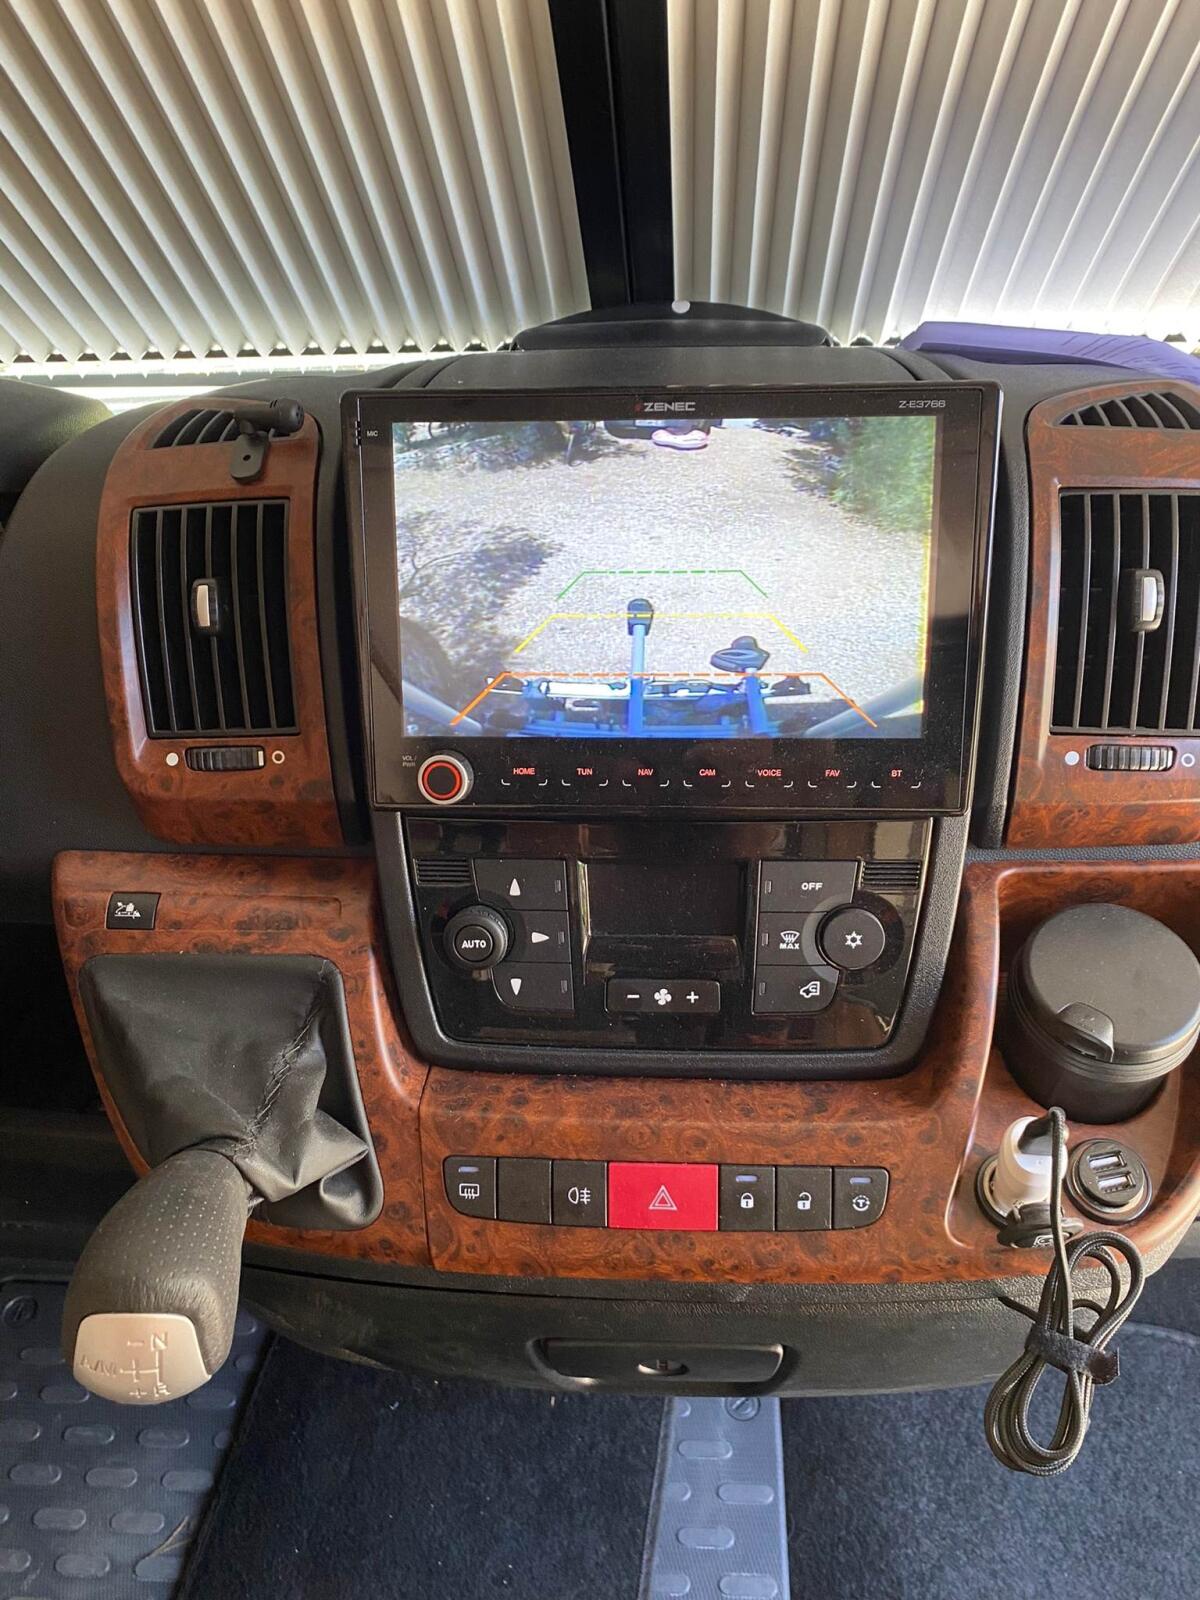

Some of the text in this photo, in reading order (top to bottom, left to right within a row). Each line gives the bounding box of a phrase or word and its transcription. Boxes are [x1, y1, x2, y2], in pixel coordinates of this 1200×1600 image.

[643, 402, 696, 412] ZENEC
[898, 400, 946, 408] Z-E3766
[513, 767, 536, 775] HOME
[576, 767, 593, 775] TUN
[637, 768, 654, 776] NAV
[699, 768, 716, 776] CAM
[757, 769, 782, 777] VOICE
[825, 769, 840, 777] FAV
[891, 769, 903, 777] BT
[801, 882, 823, 890] OFF
[461, 939, 487, 949] AUTO
[779, 942, 800, 950] MAX
